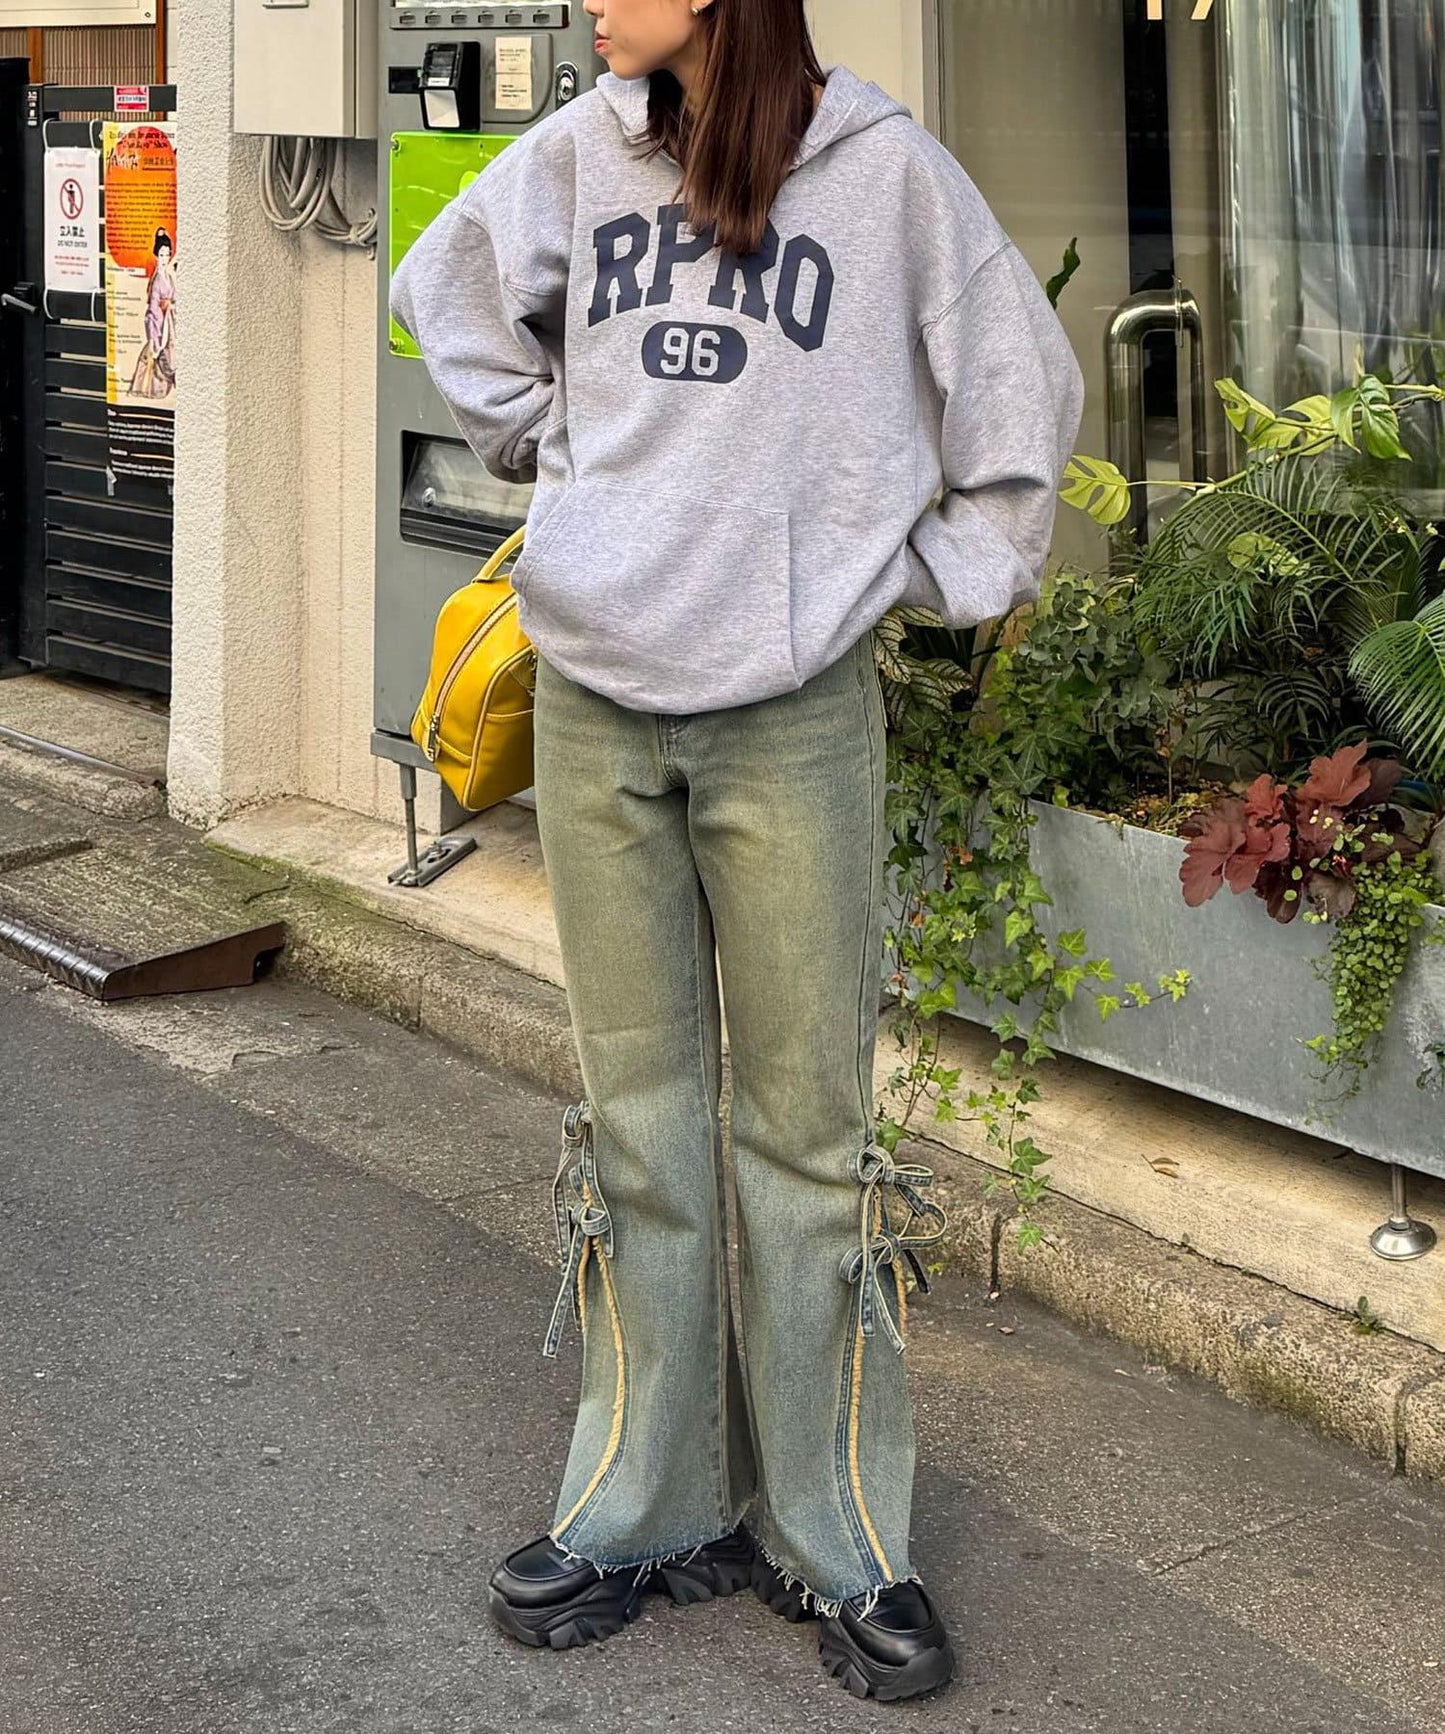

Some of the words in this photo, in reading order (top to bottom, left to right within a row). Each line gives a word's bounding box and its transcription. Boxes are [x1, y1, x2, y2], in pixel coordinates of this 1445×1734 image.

[60, 226, 85, 237] 立入禁止
[588, 203, 834, 352] RPRO
[660, 327, 721, 377] 96
